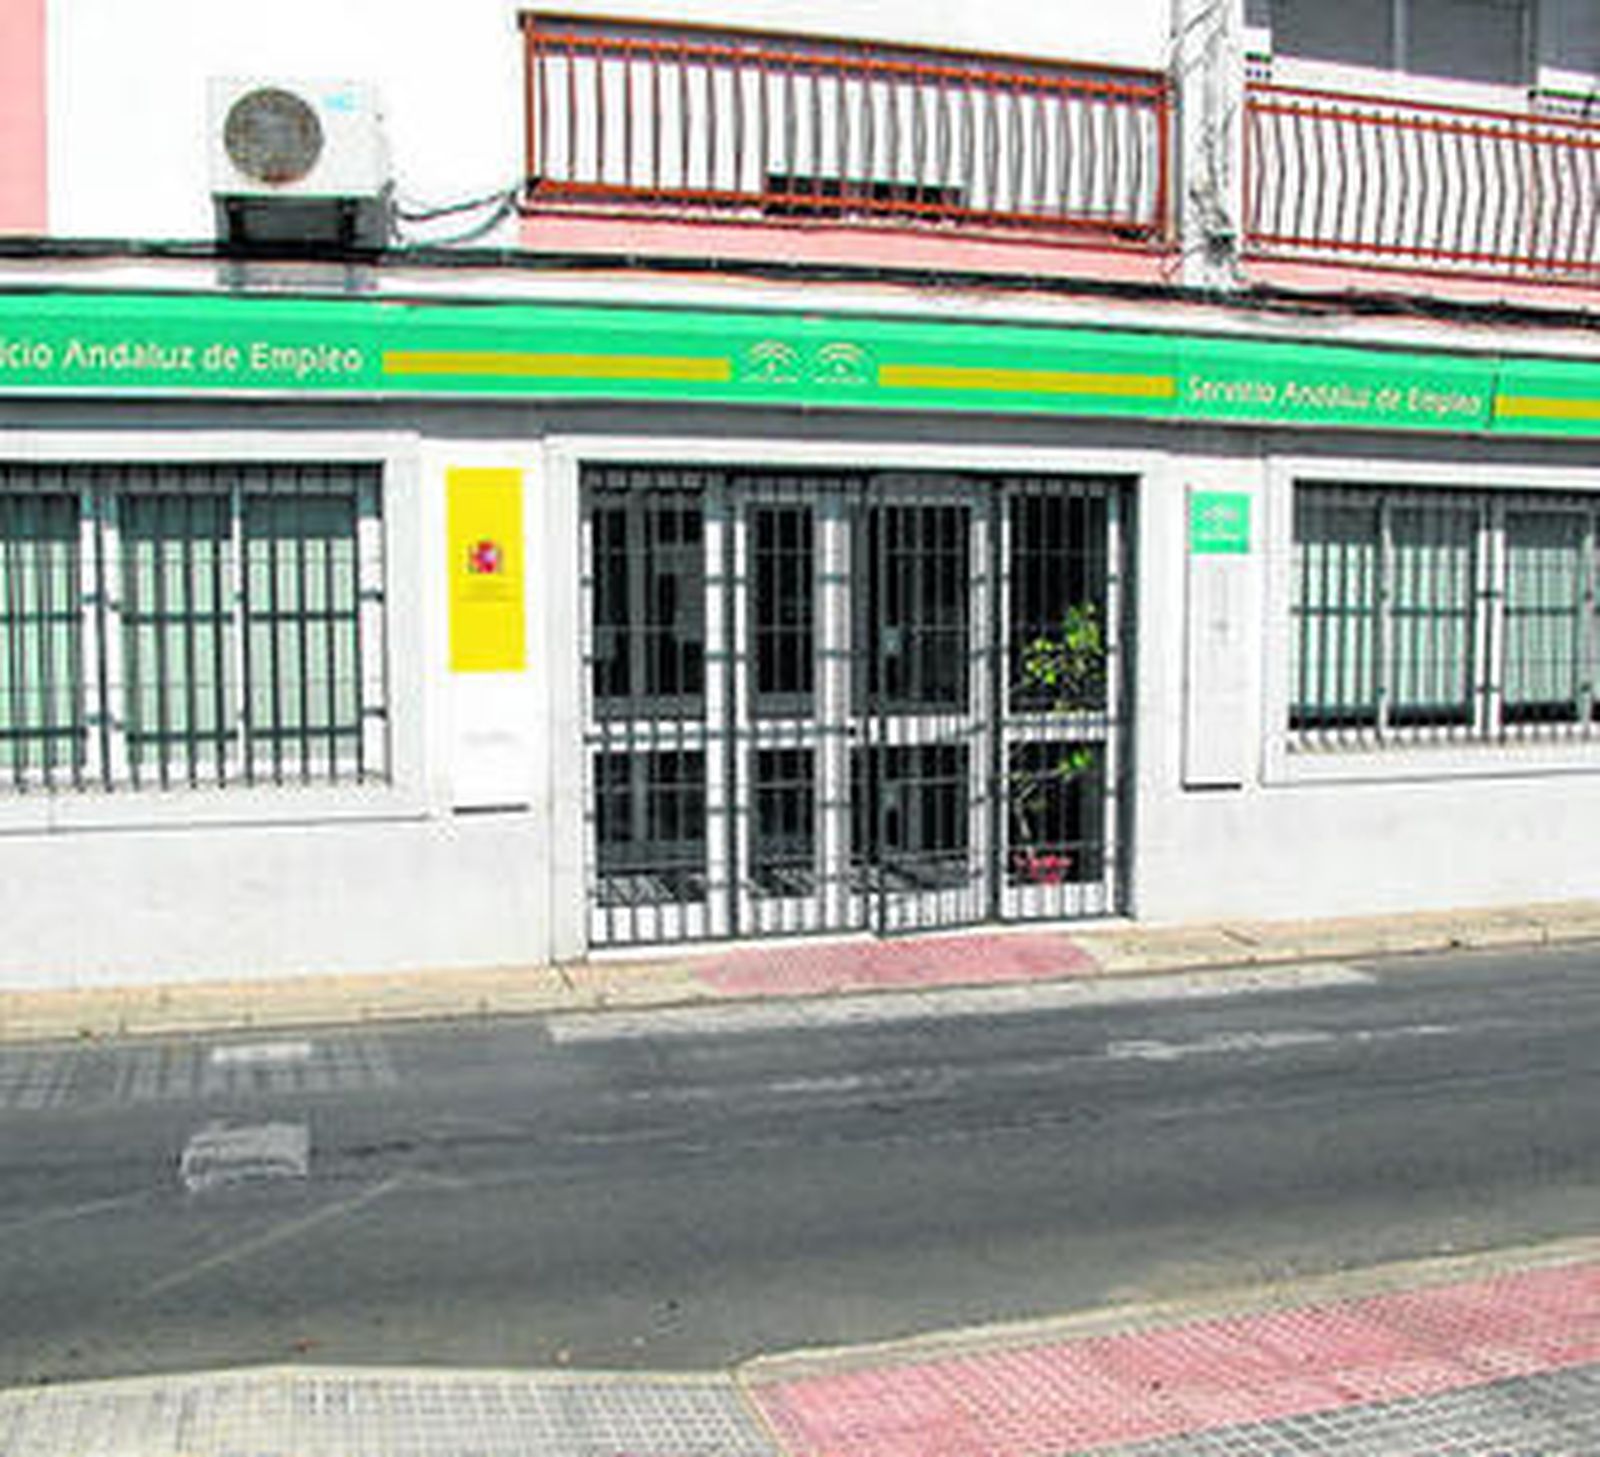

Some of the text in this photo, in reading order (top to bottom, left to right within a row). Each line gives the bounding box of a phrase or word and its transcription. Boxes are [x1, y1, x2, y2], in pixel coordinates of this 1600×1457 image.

[60, 338, 194, 370] Andaluz
[202, 341, 239, 369] de
[250, 343, 363, 377] Empleo
